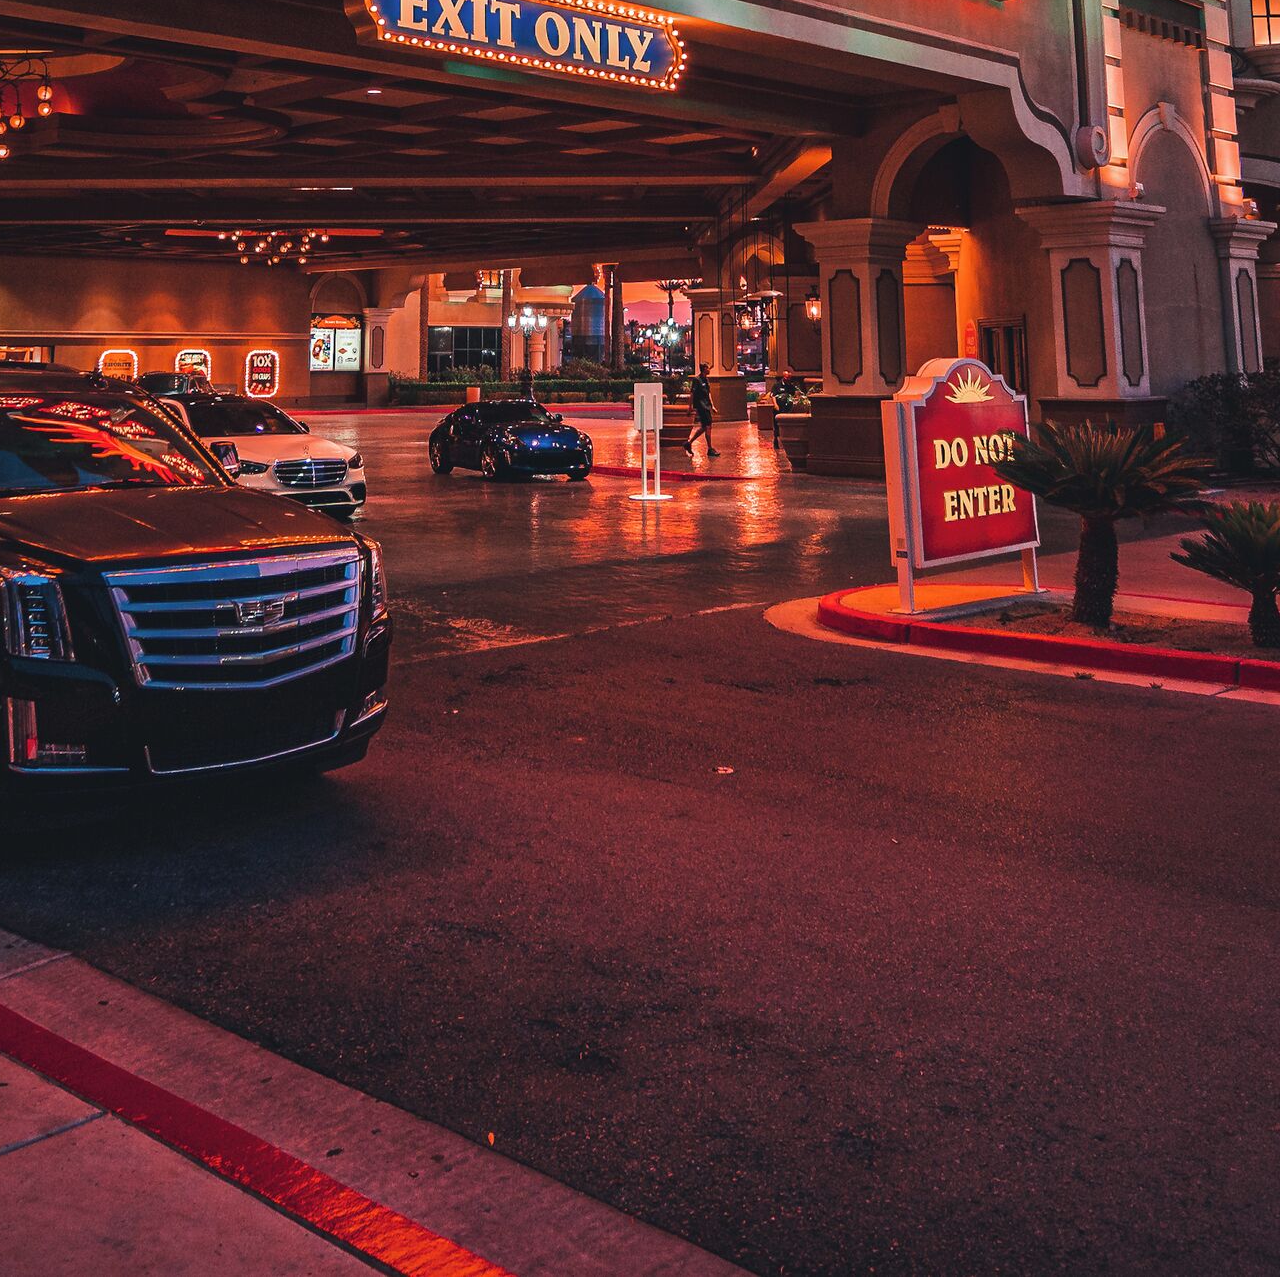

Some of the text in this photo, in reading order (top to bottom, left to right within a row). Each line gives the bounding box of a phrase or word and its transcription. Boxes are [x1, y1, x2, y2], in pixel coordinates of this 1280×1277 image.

[534, 10, 654, 73] ONLY
[252, 354, 272, 368] 10X
[933, 432, 1016, 470] DO NOT
[943, 484, 1017, 523] ENTER
